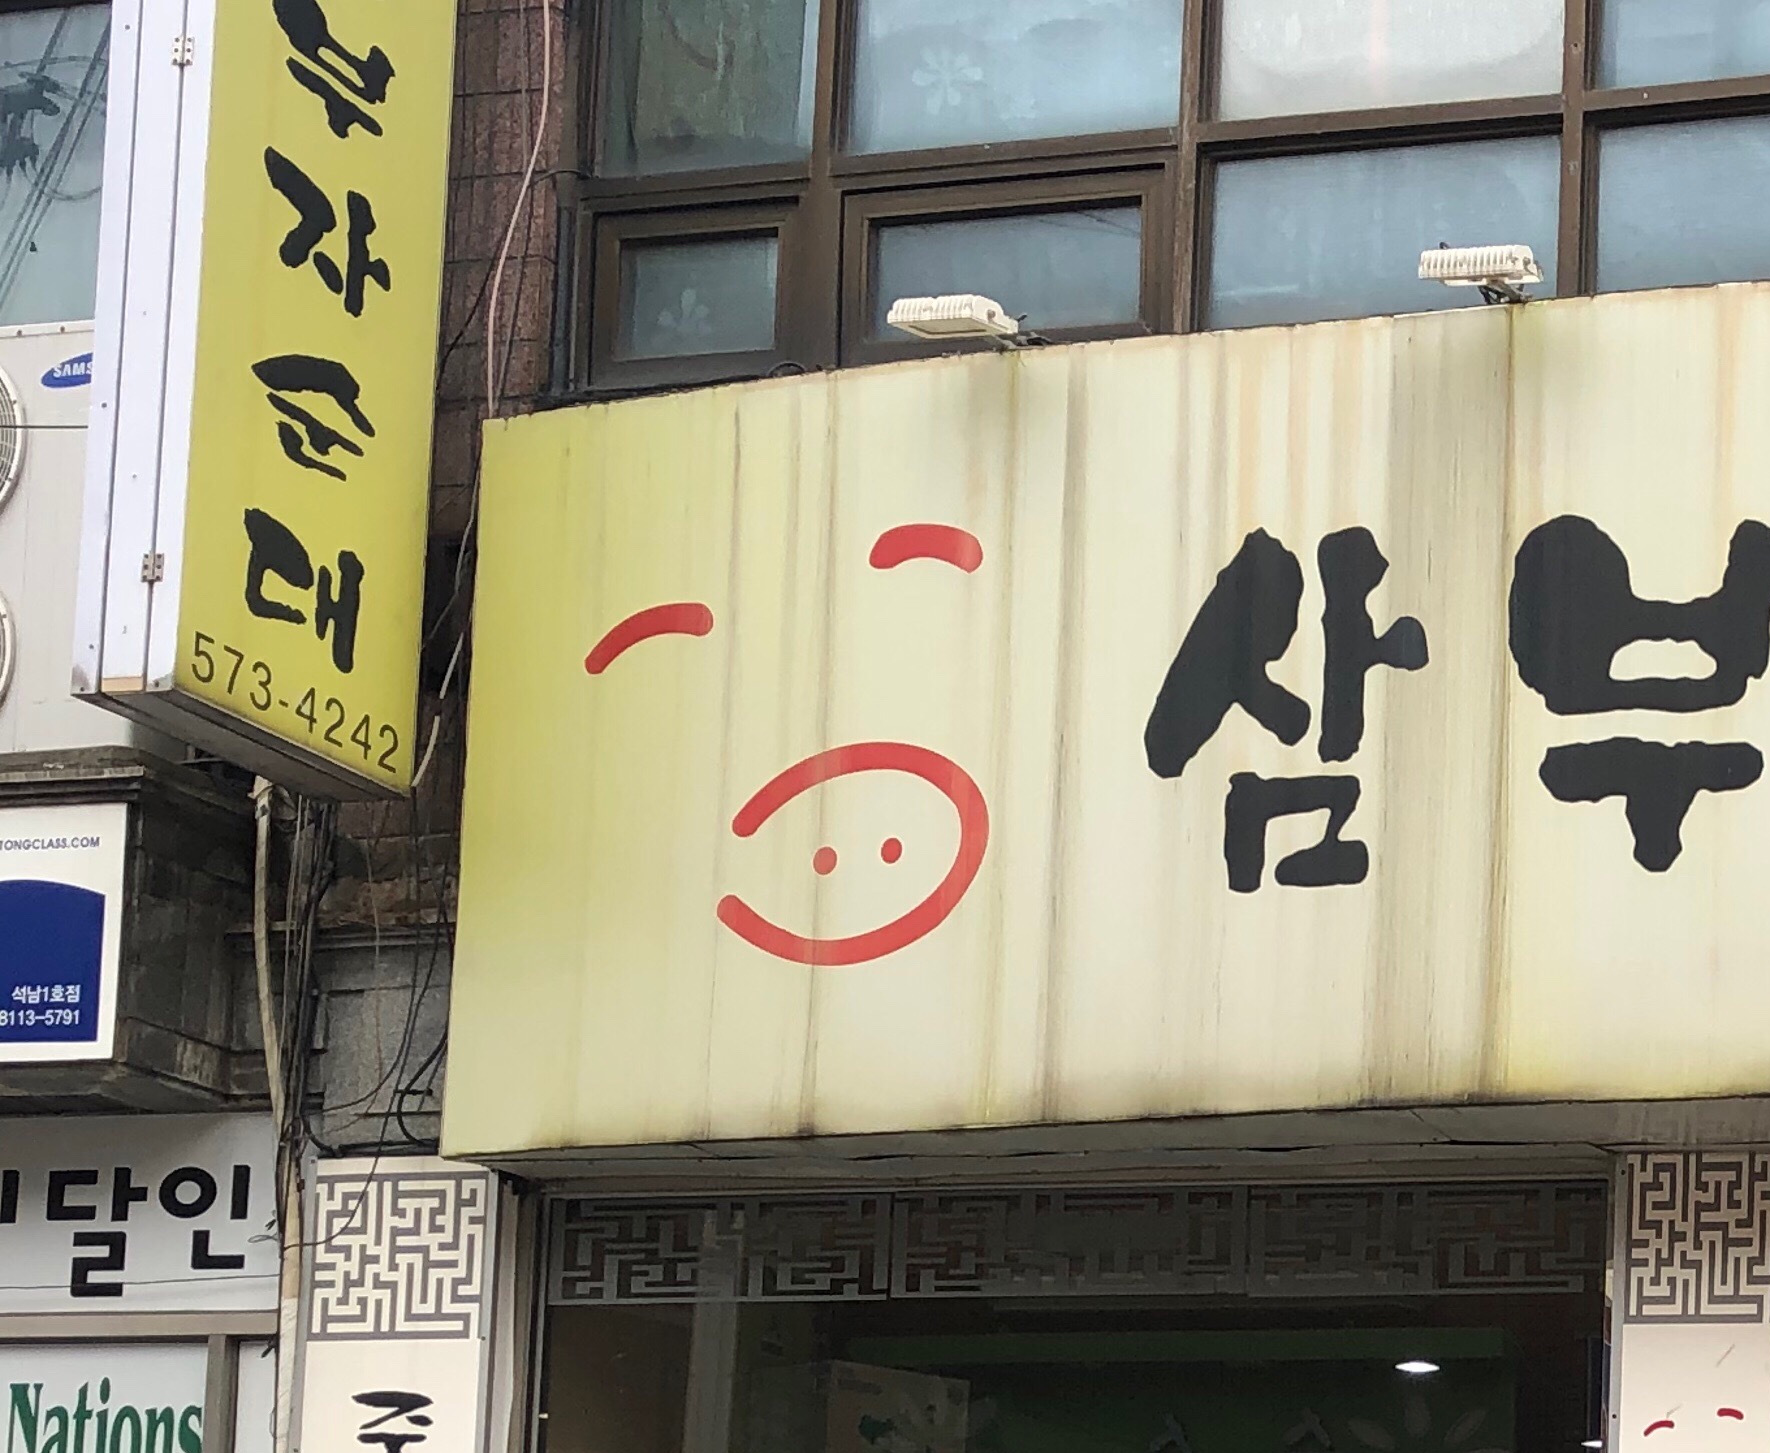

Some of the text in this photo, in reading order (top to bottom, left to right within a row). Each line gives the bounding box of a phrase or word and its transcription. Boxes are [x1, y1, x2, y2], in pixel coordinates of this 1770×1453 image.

[190, 630, 400, 774] 573-4242
[11, 985, 80, 1004] 석남1호점
[46, 1164, 250, 1297] 달인
